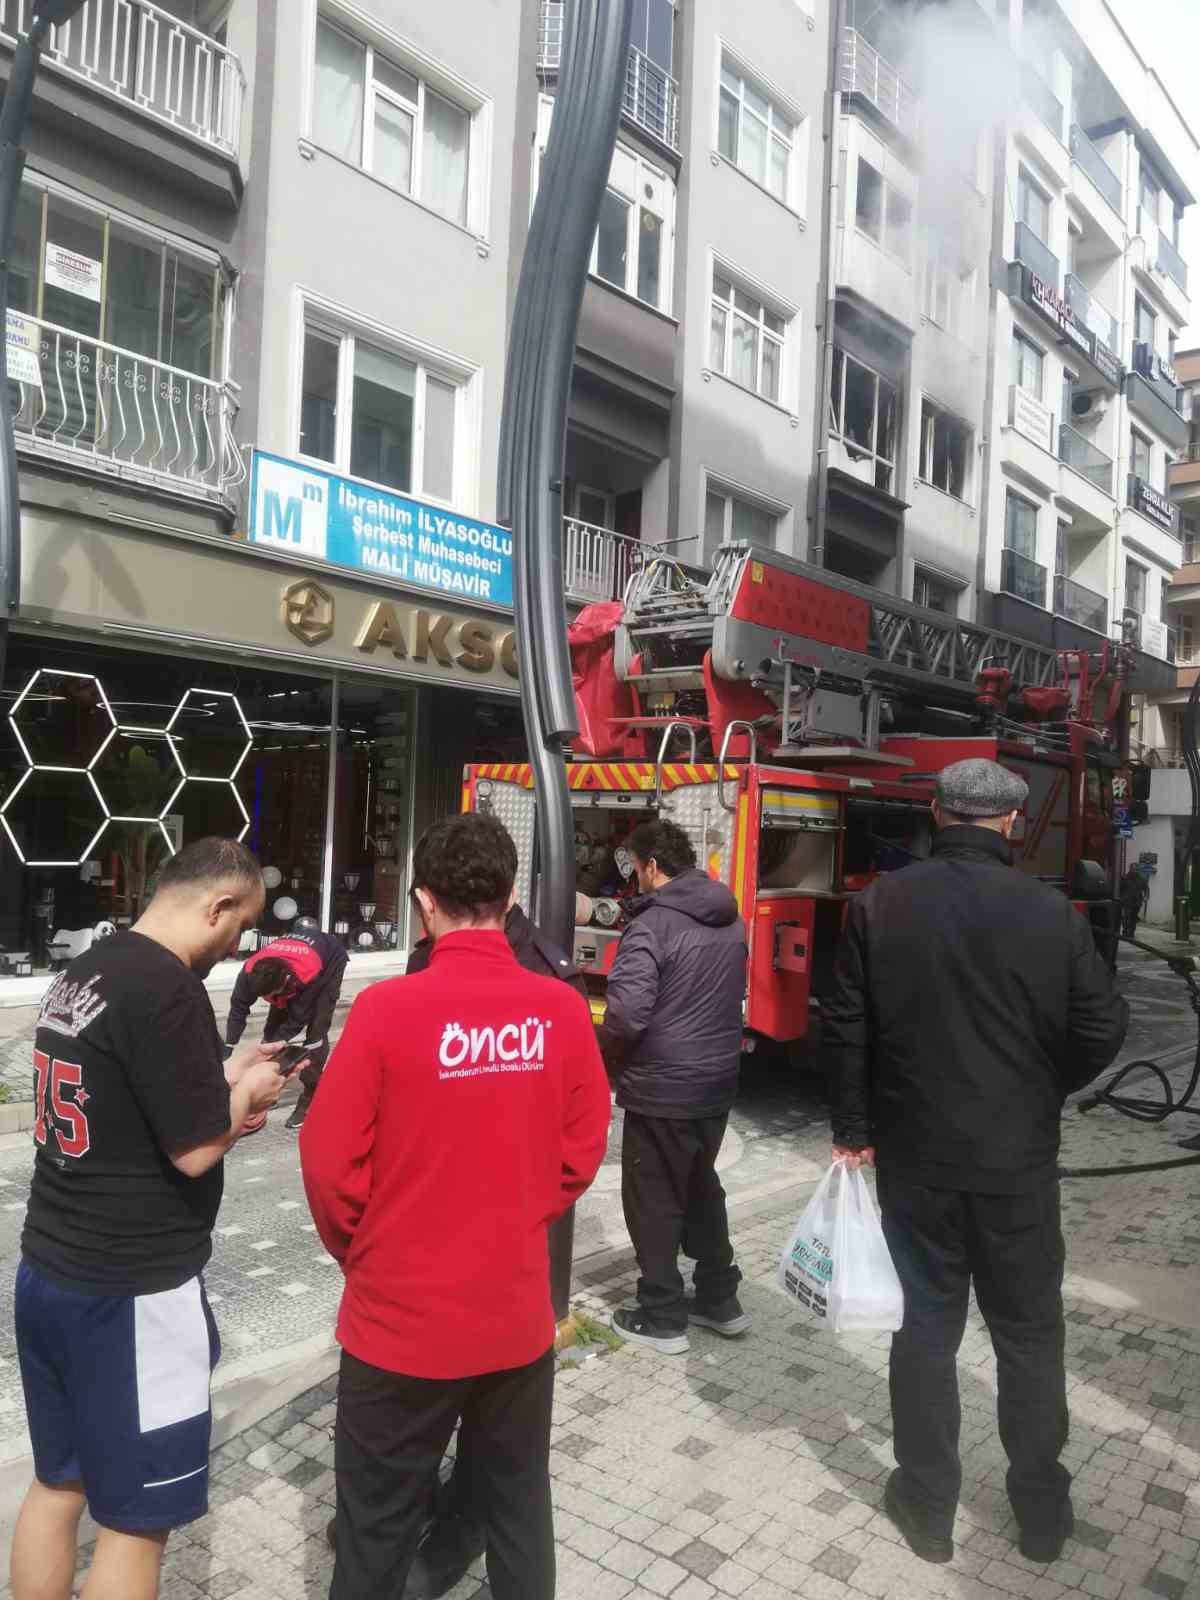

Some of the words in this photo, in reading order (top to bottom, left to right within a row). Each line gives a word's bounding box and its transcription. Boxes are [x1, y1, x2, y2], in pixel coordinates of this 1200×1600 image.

[338, 482, 412, 526] İbrahim
[417, 507, 513, 556] İLYASOĞLU
[352, 516, 415, 550] Serbest
[418, 536, 502, 576] Muhasebeci
[362, 545, 408, 576] MALİ
[413, 559, 491, 598] MÜŞAVİR
